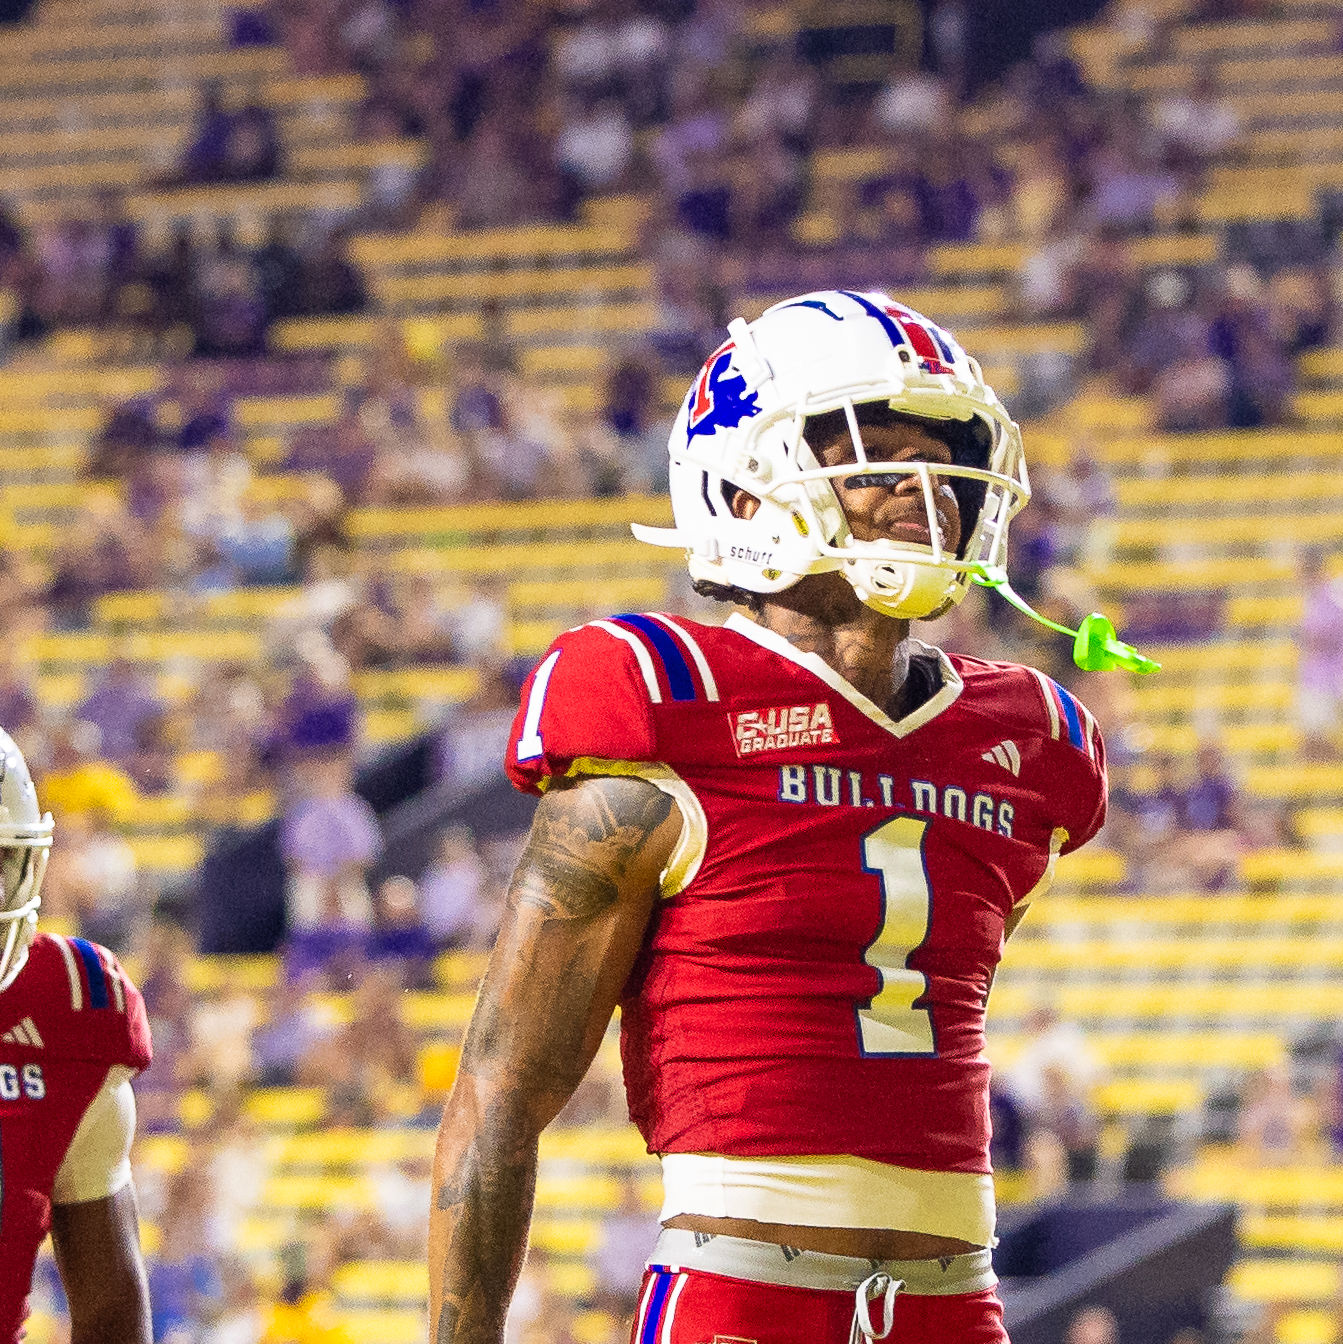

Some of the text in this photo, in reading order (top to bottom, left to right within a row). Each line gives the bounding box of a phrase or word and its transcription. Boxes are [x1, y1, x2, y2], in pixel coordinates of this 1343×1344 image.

[517, 648, 563, 764] 1
[738, 727, 834, 755] GRADUATE
[855, 811, 940, 1059] 1
